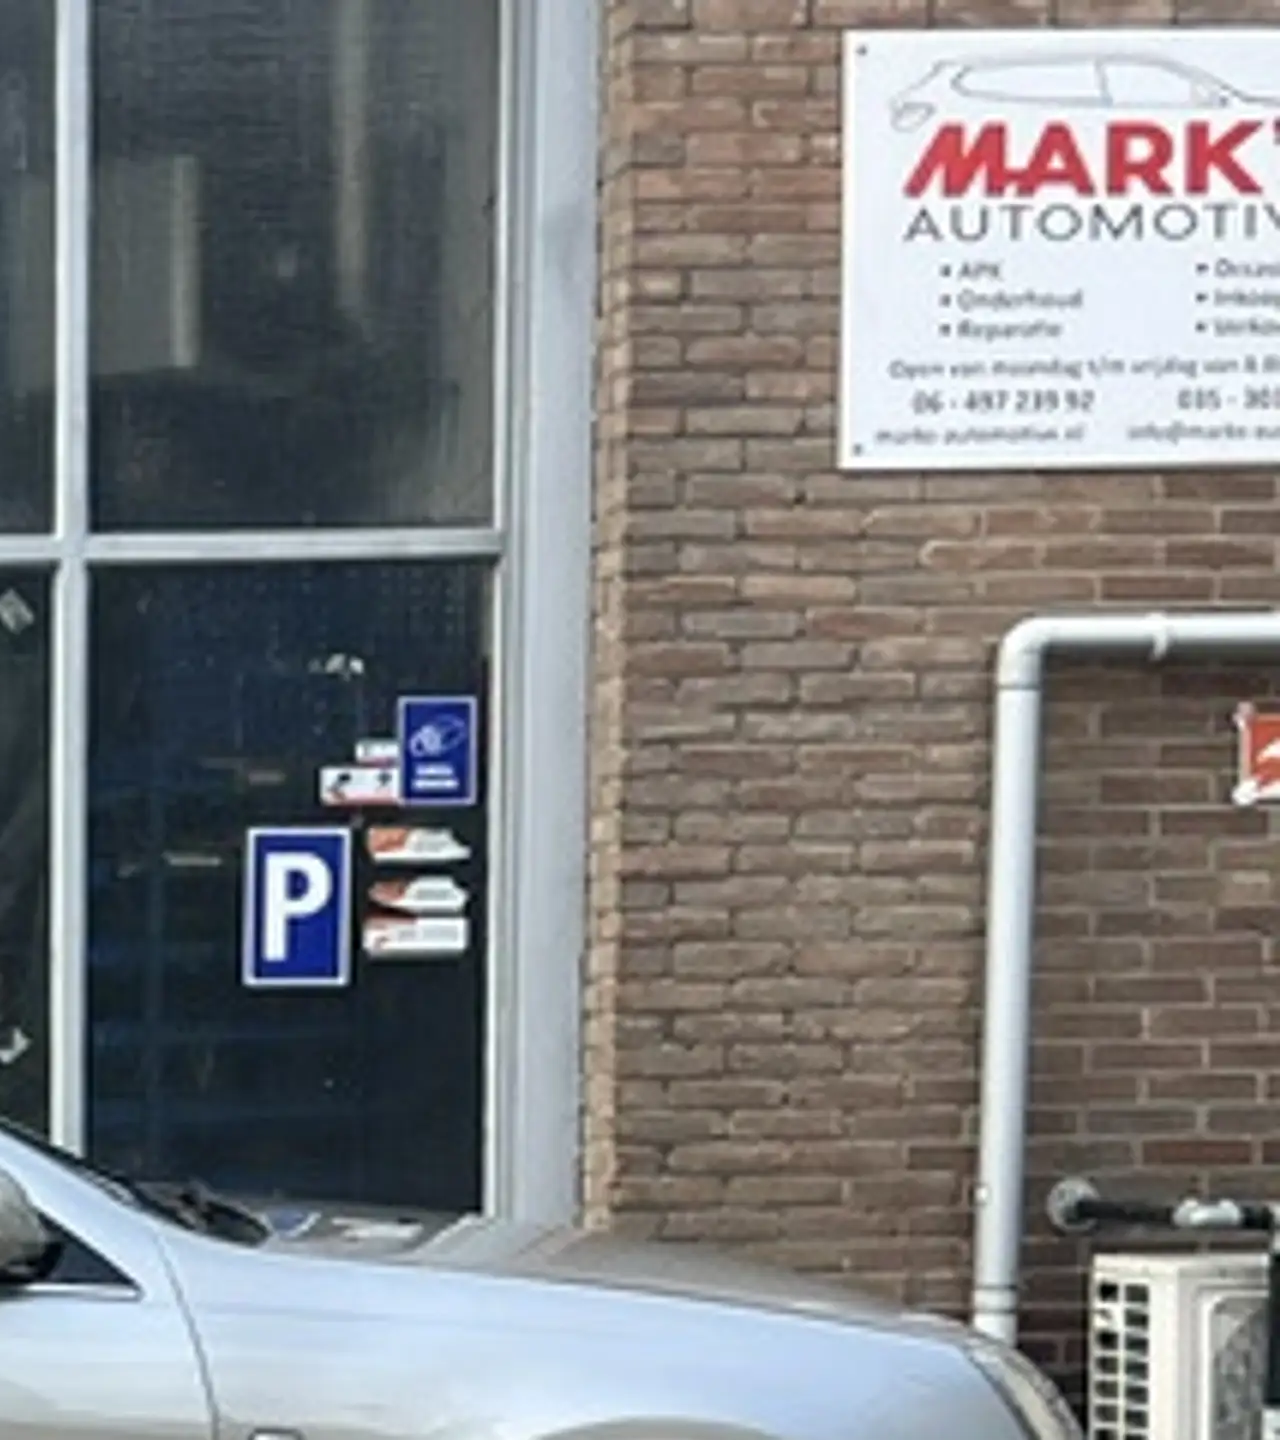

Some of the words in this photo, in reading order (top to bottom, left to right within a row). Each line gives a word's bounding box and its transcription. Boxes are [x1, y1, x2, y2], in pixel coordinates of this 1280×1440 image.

[957, 261, 1001, 280] APK
[956, 288, 1084, 309] Onderhoud
[956, 319, 1064, 343] Reparatie
[887, 359, 945, 381] Open
[949, 361, 987, 378] van
[991, 357, 1084, 381] maandag
[1130, 356, 1199, 380] vrijdag
[1202, 358, 1240, 374] van
[911, 390, 945, 415] 06
[263, 852, 332, 961] P
